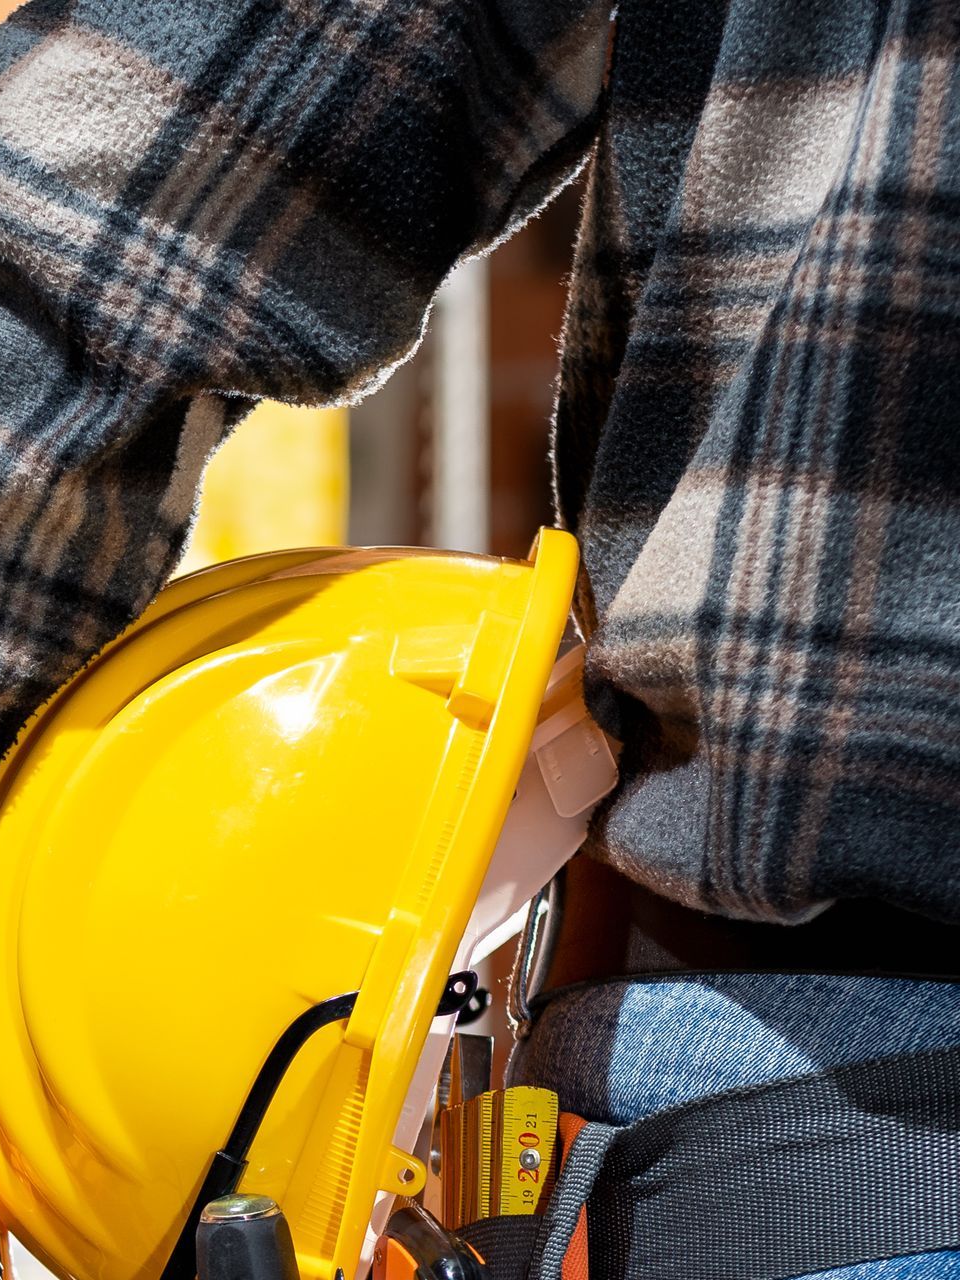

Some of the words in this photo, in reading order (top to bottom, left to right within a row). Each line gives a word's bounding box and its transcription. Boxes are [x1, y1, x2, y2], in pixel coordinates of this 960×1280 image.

[526, 1113, 538, 1129] 21
[518, 1133, 540, 1184] 20
[523, 1190, 534, 1206] 19
